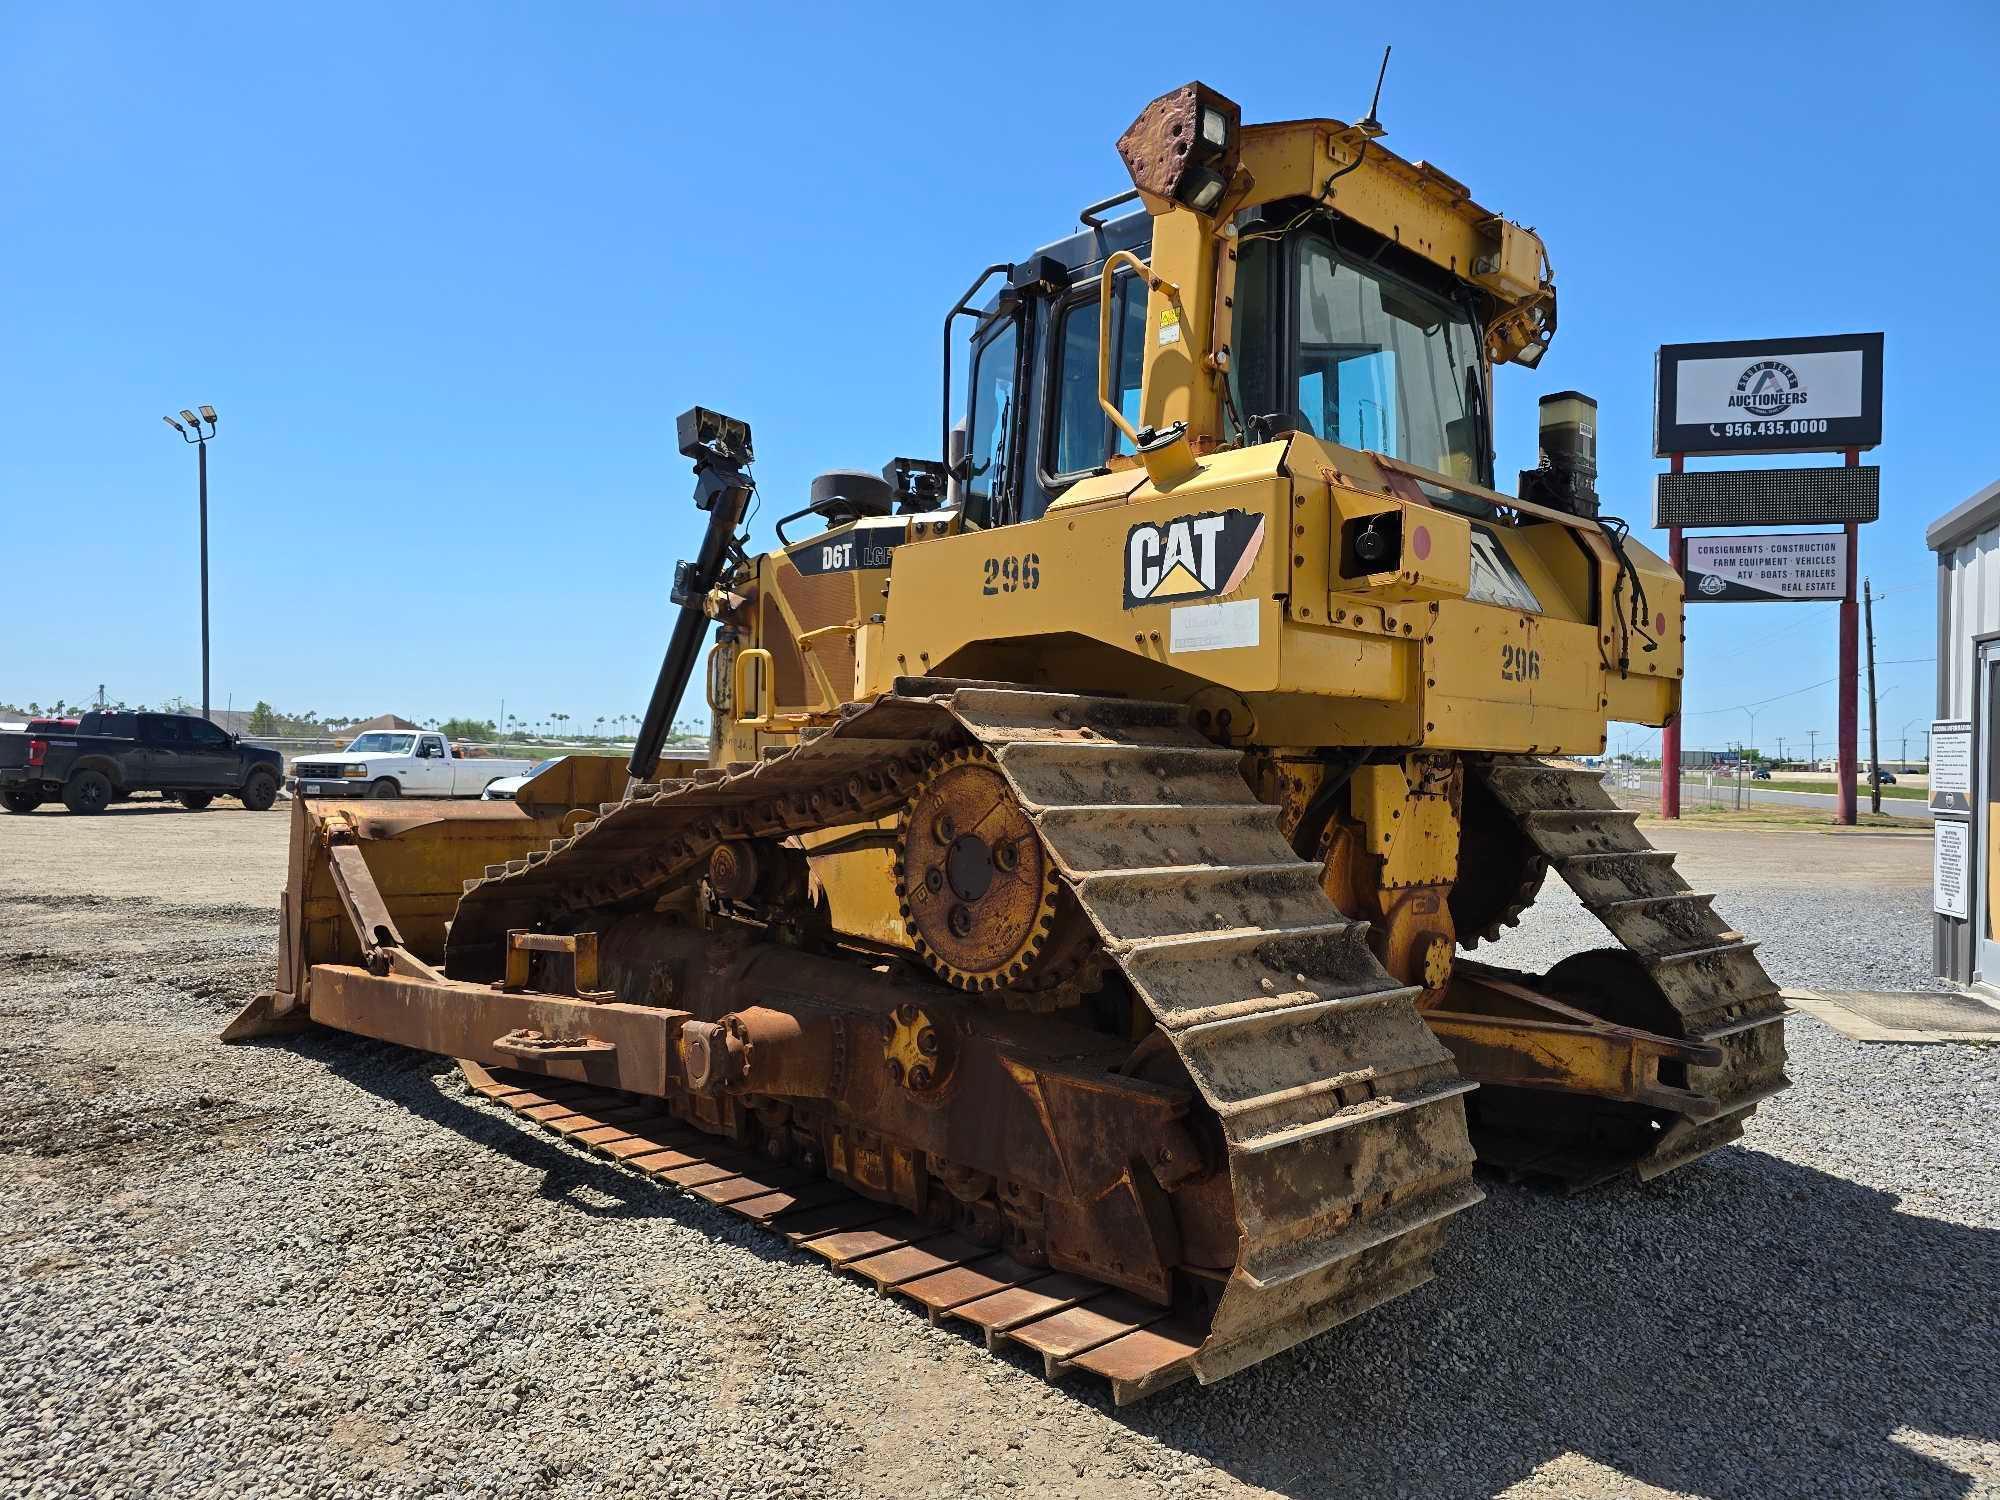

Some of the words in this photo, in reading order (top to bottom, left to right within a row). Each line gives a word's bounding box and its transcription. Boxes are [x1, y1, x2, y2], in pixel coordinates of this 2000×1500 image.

[1738, 362, 1765, 388] SOUTH
[1773, 362, 1798, 384] TEXAS
[1728, 392, 1808, 407] AUCTIONEERS
[1725, 420, 1828, 437] 956.435.0000
[822, 543, 853, 570] D6T
[1130, 515, 1225, 599] CAT
[1697, 545, 1763, 554] CONSIGNMENTS
[1771, 543, 1836, 553] CONSTRUCTION
[1713, 558, 1736, 567] FARM
[1739, 557, 1788, 566] EQUIPMENT
[1796, 555, 1836, 565] VEHICLES
[983, 552, 1040, 596] 296
[1737, 570, 1753, 579] ATV
[1761, 570, 1788, 579] BOATS
[1796, 569, 1836, 578] TRAILERS
[1781, 583, 1802, 591] REAL
[1805, 582, 1836, 591] ESTATE
[1501, 643, 1540, 683] 296
